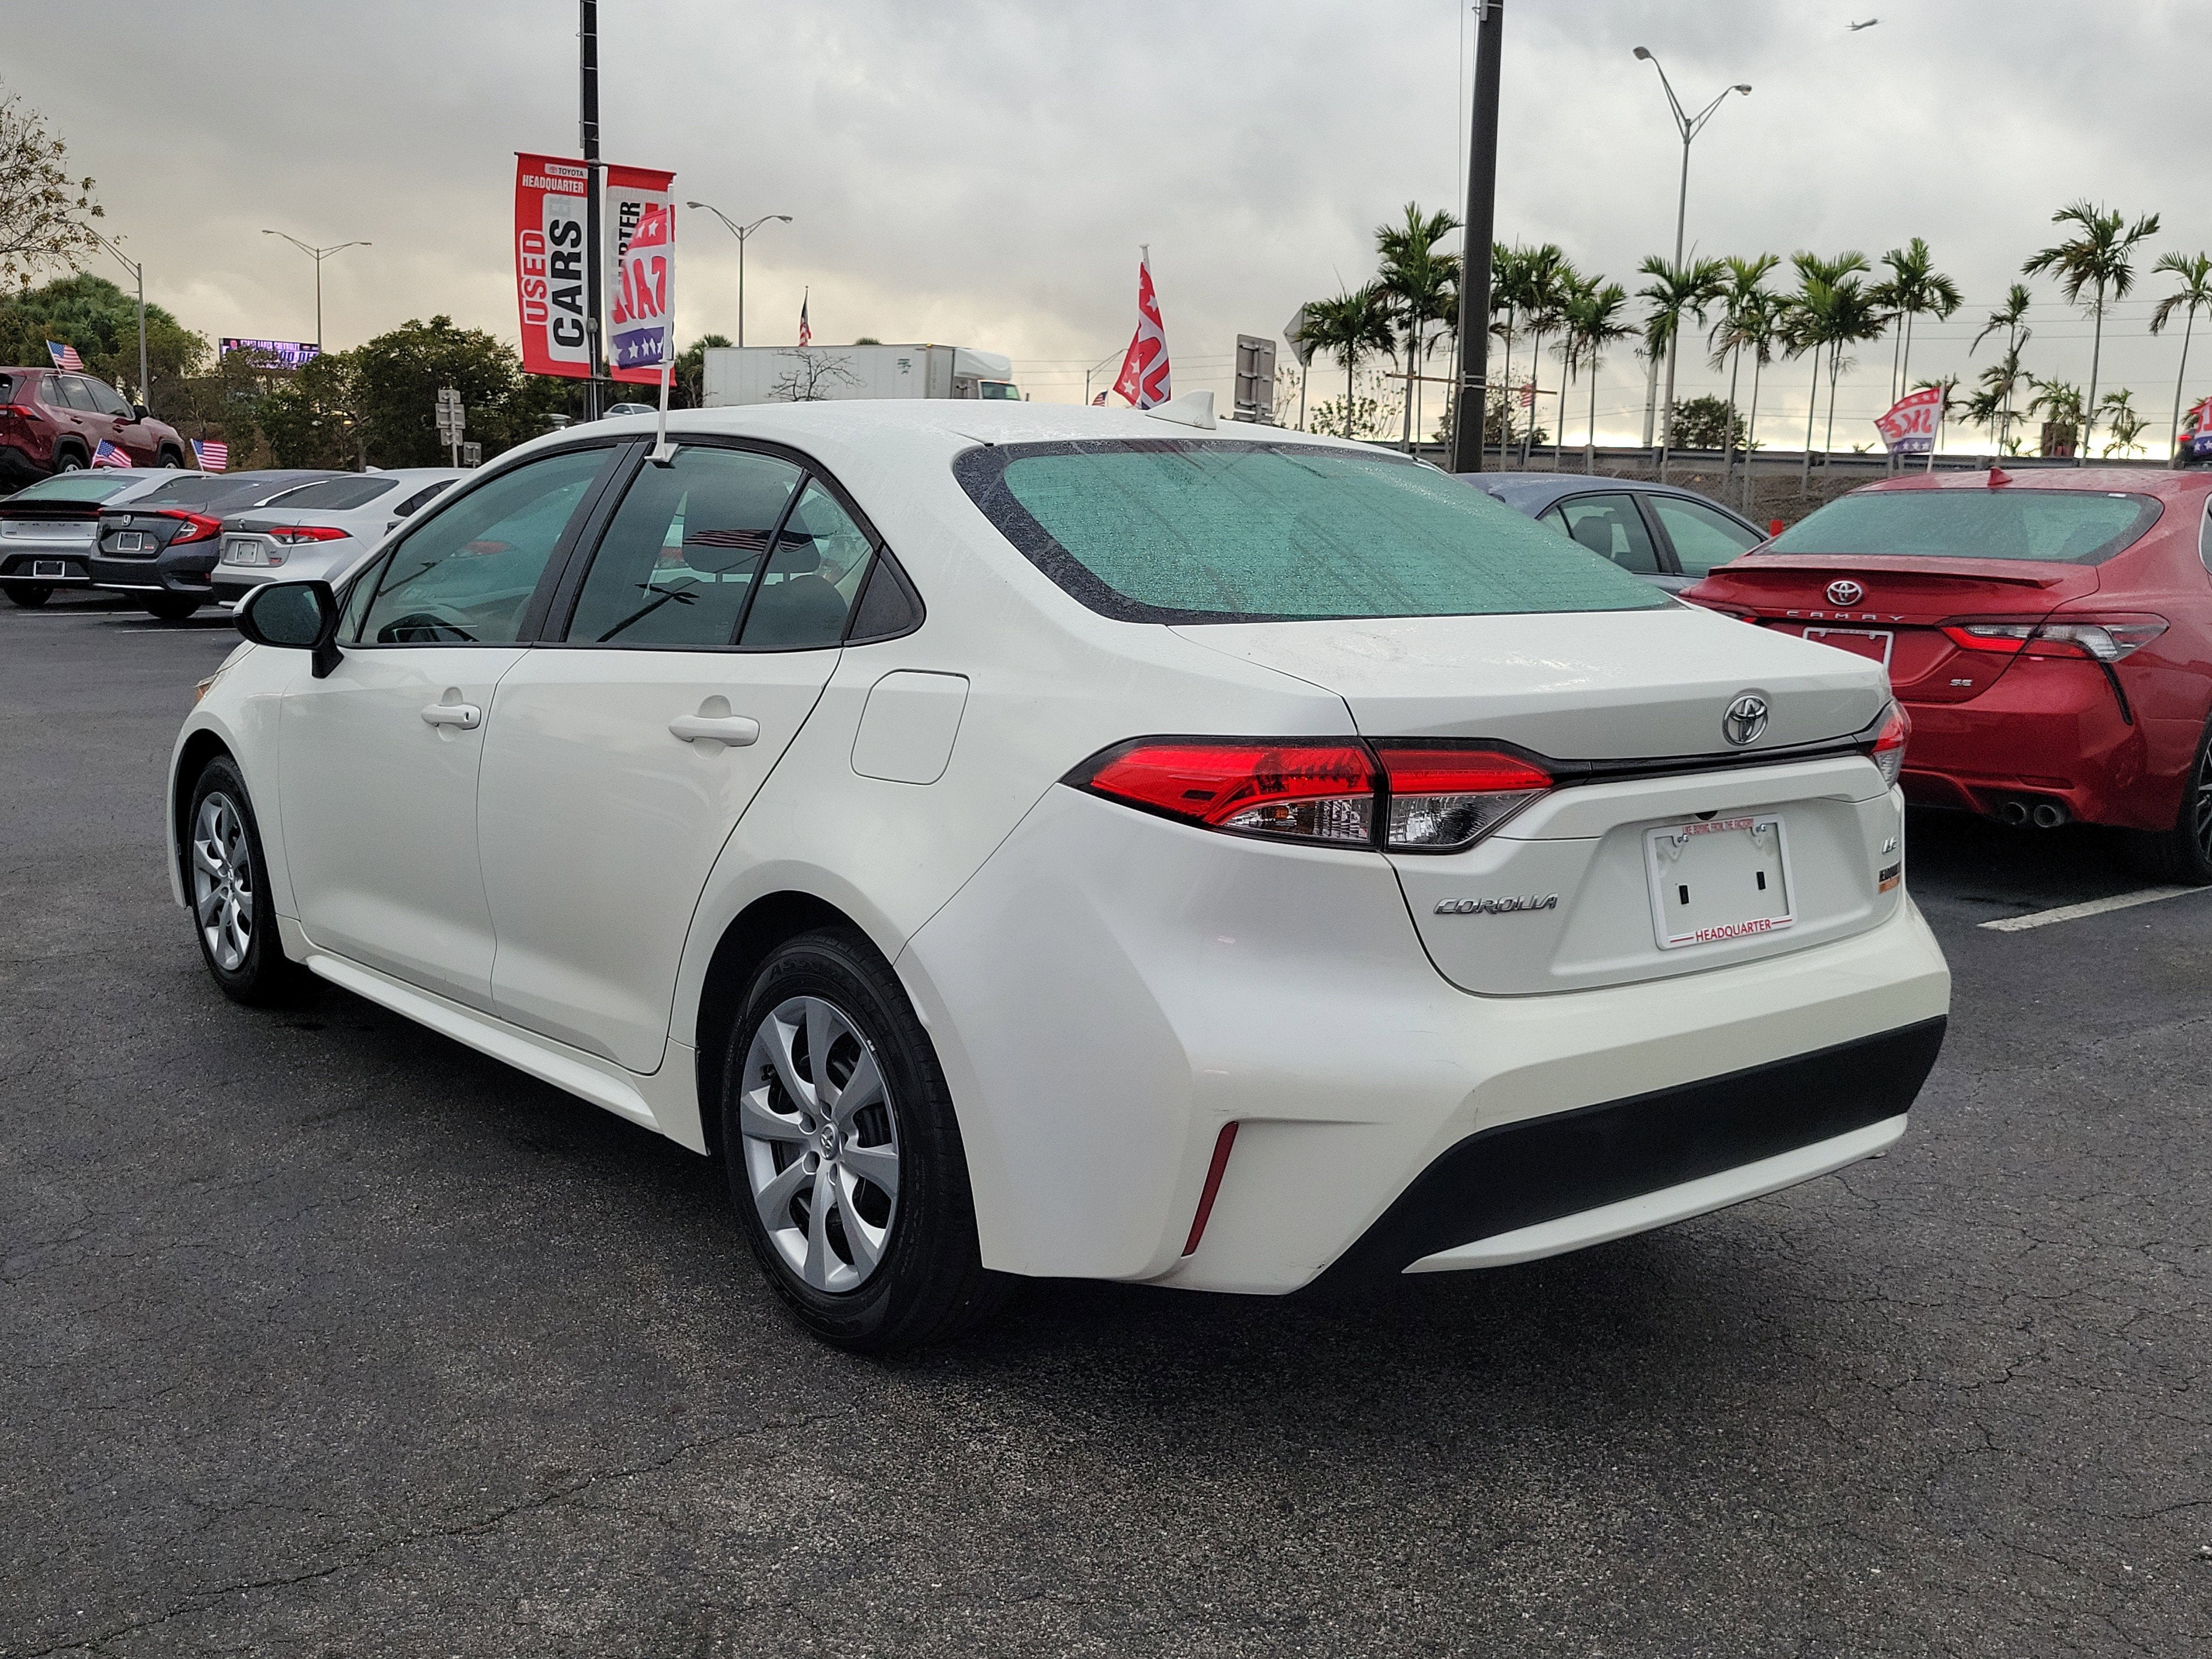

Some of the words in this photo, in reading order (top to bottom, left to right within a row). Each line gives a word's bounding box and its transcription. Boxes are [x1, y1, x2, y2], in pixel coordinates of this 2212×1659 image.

[558, 167, 584, 177] TOYOTA
[522, 174, 584, 194] HEADQUARTER
[521, 231, 548, 324] USED
[549, 219, 585, 348] CARS
[1786, 610, 1905, 621] CAMRY
[1949, 678, 1973, 686] SE
[1881, 835, 1898, 854] LE
[1433, 892, 1559, 915] COROLLA
[1695, 918, 1771, 942] HEADQUARTER
